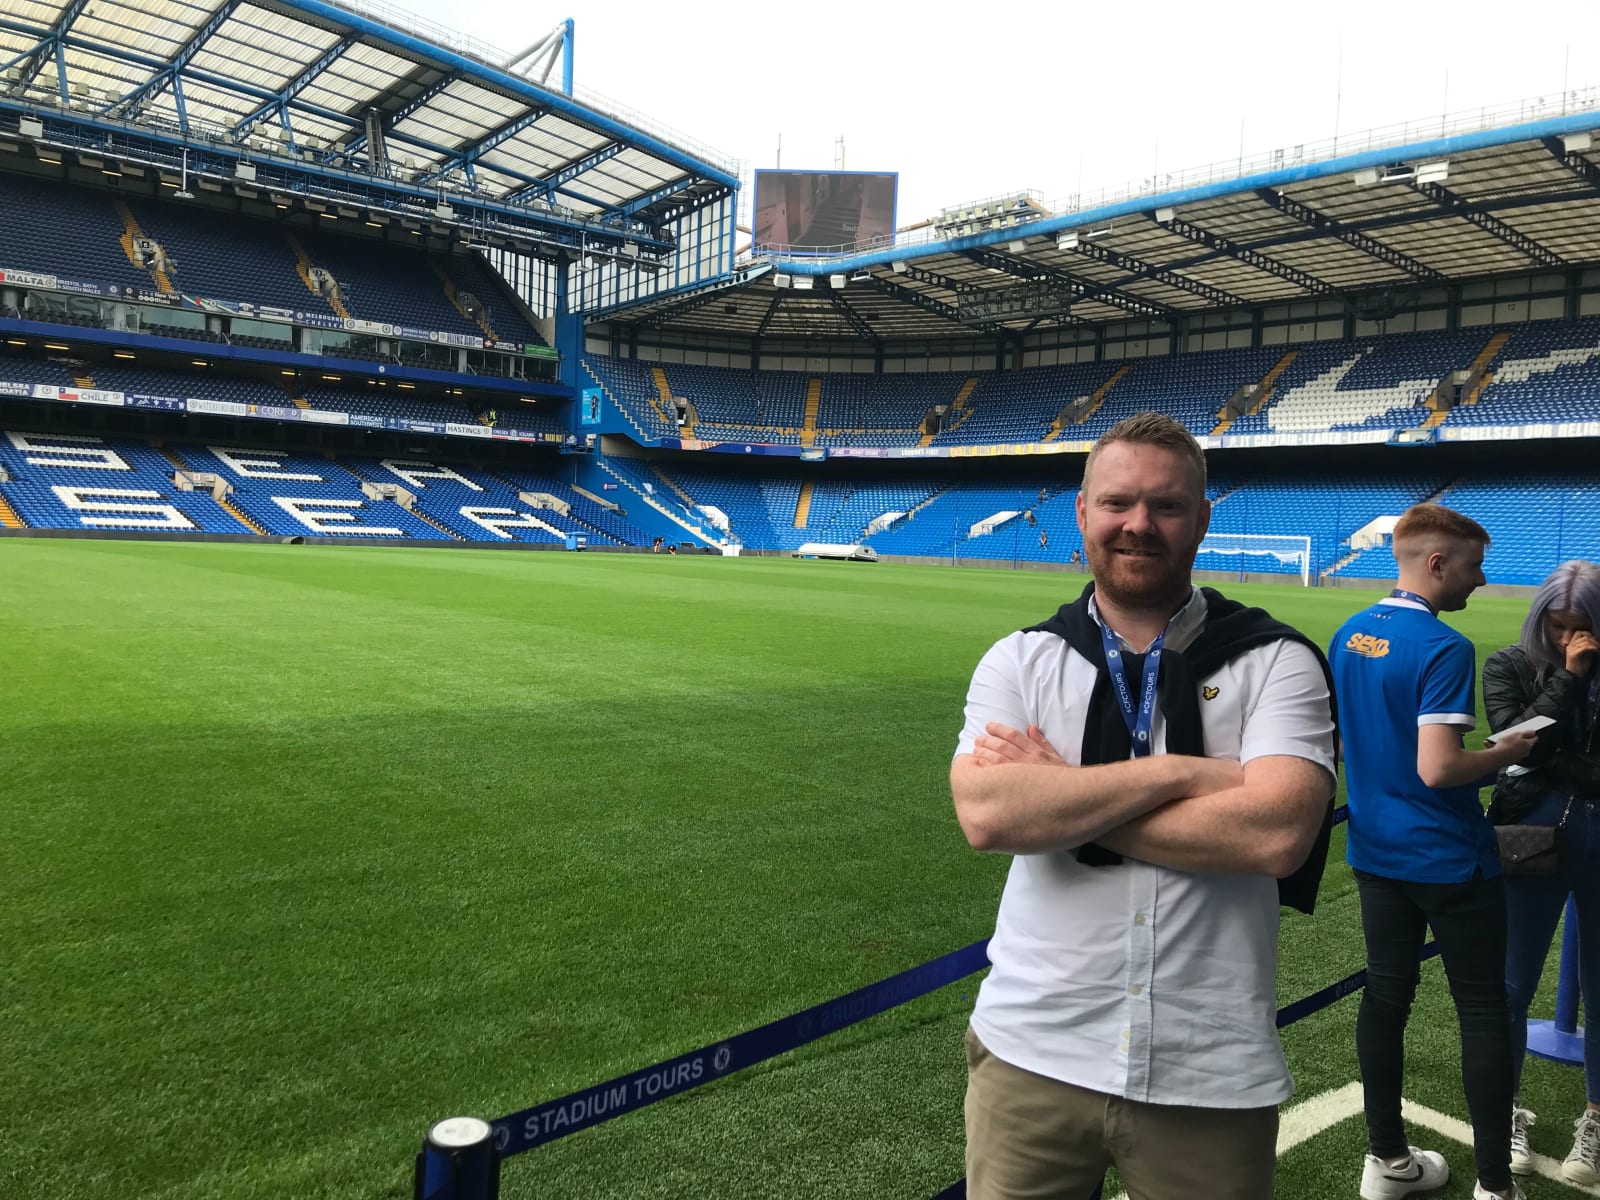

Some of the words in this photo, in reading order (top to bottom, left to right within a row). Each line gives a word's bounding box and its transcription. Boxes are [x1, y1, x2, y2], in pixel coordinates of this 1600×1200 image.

[6, 274, 44, 286] MALTA
[305, 312, 343, 323] MELBOURNE
[305, 320, 343, 329] CHELSEA
[81, 393, 109, 402] CHILE
[261, 406, 286, 417] CORK
[350, 414, 384, 423] AMERICAN
[447, 425, 481, 435] HASTINGS
[1459, 426, 1520, 440] CHELSEA
[1523, 424, 1553, 438] OUR
[1115, 672, 1133, 714] #CFCTOURS
[1143, 672, 1155, 714] #CFCTOURS
[524, 1084, 627, 1140] STADIUM
[634, 1057, 704, 1099] TOURS
